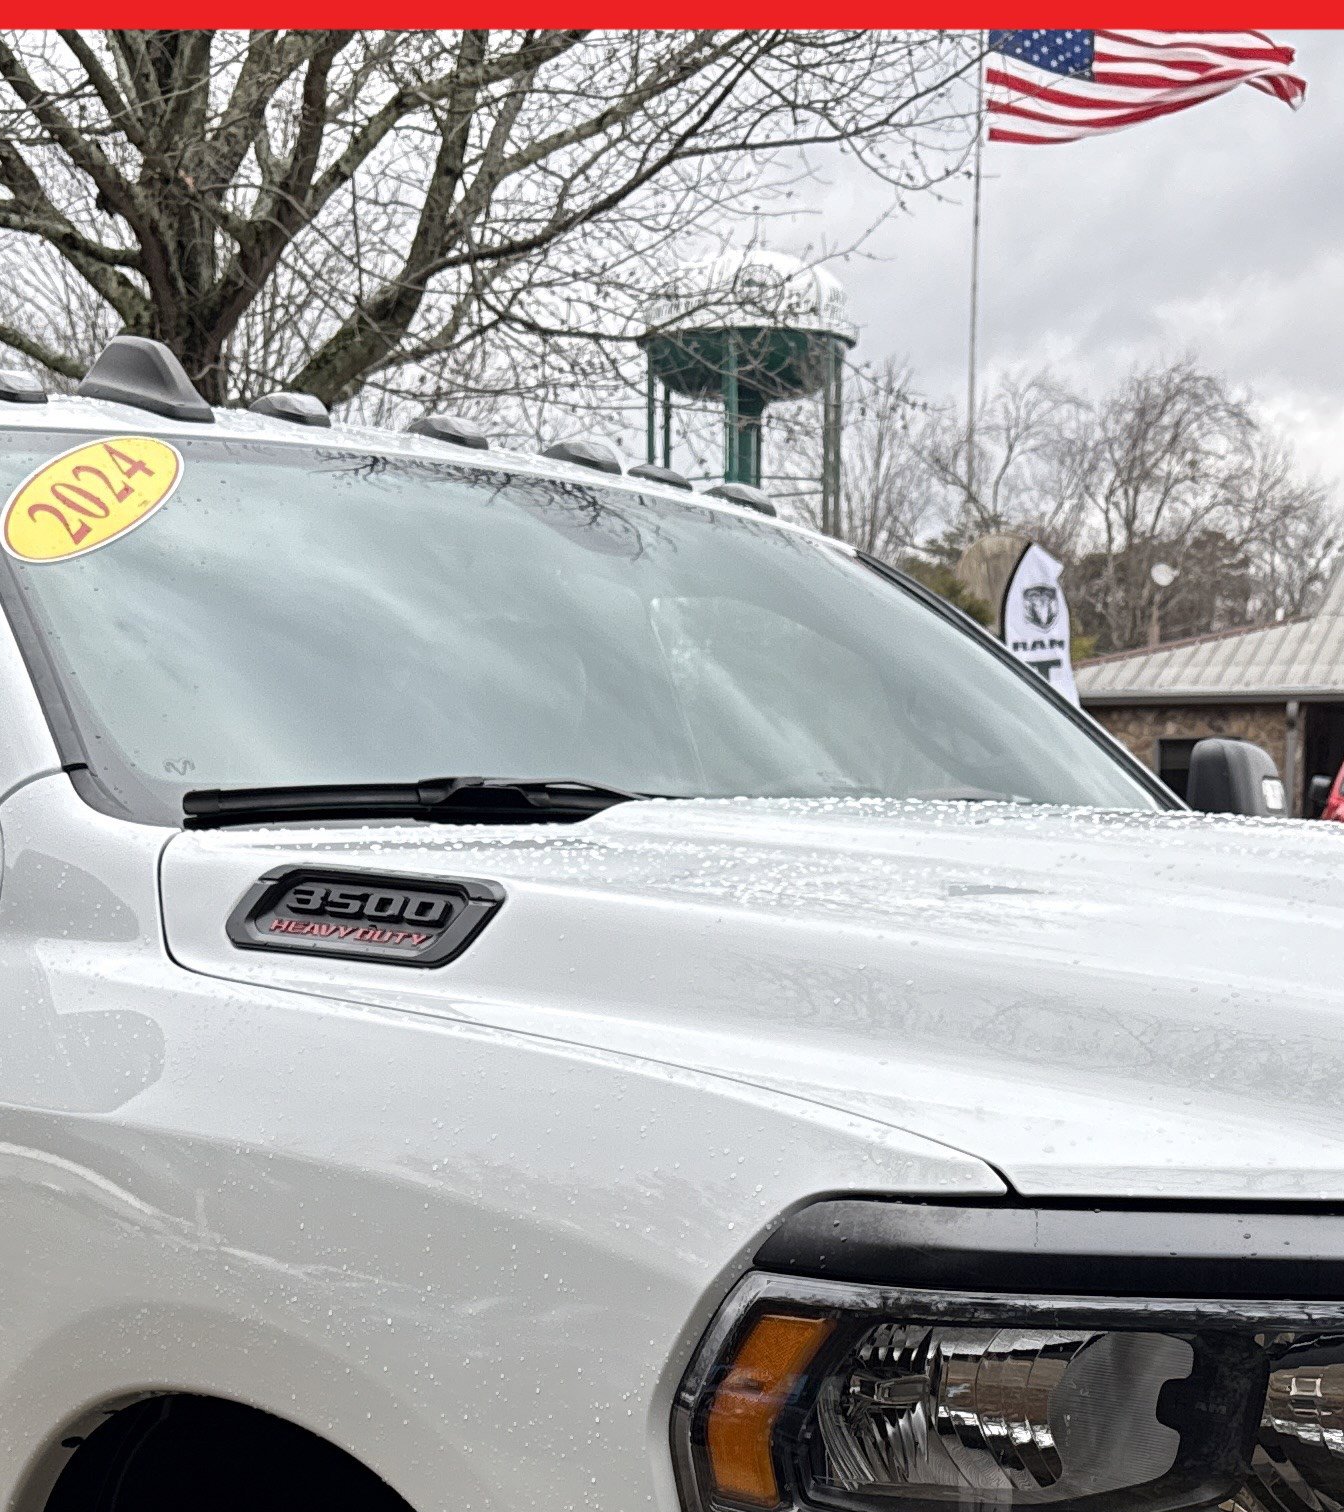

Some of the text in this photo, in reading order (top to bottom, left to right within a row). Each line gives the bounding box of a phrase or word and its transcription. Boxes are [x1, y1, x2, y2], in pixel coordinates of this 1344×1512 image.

[28, 443, 155, 545] 2024
[1012, 639, 1065, 652] RAM
[286, 887, 453, 928] 3500
